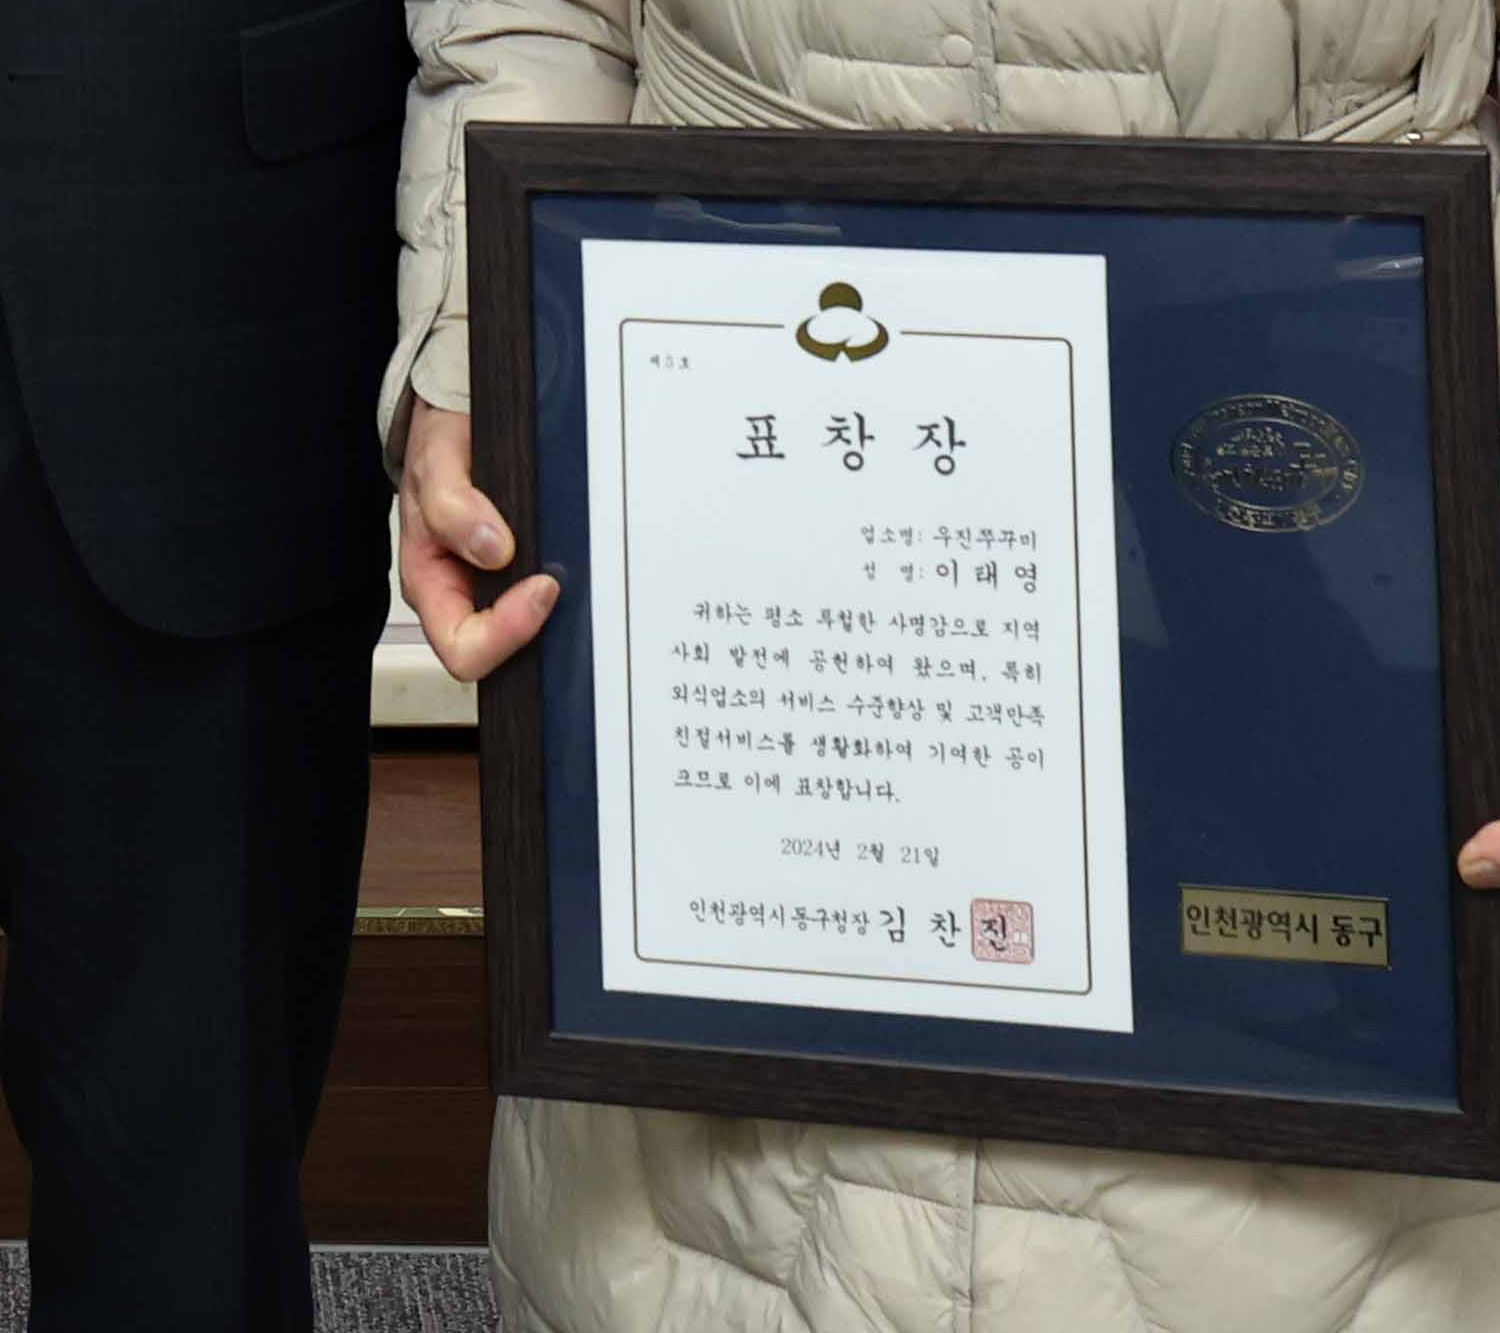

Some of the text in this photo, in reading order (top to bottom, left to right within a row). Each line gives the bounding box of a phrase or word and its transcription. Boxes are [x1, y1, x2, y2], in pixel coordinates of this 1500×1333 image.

[693, 600, 753, 626] 귀하는
[765, 604, 804, 629] 평소
[889, 612, 990, 638] 사명감으로
[1003, 618, 1040, 643] 지역
[671, 641, 710, 664] 사회
[728, 644, 790, 670] 발전에
[808, 649, 894, 675] 공헌하여
[1001, 660, 1041, 684] 특히
[671, 682, 766, 710] 외식업소의
[780, 689, 836, 713] 서비스
[935, 700, 953, 723] 및
[812, 734, 912, 761] 생활화하여
[928, 741, 993, 769] 기여한
[1004, 746, 1044, 771] 공이
[674, 768, 900, 803] 크므로 이에 표창합니다.
[780, 837, 940, 869] 2024년 2월 21일
[1186, 904, 1384, 948] 인천광역시 동구
